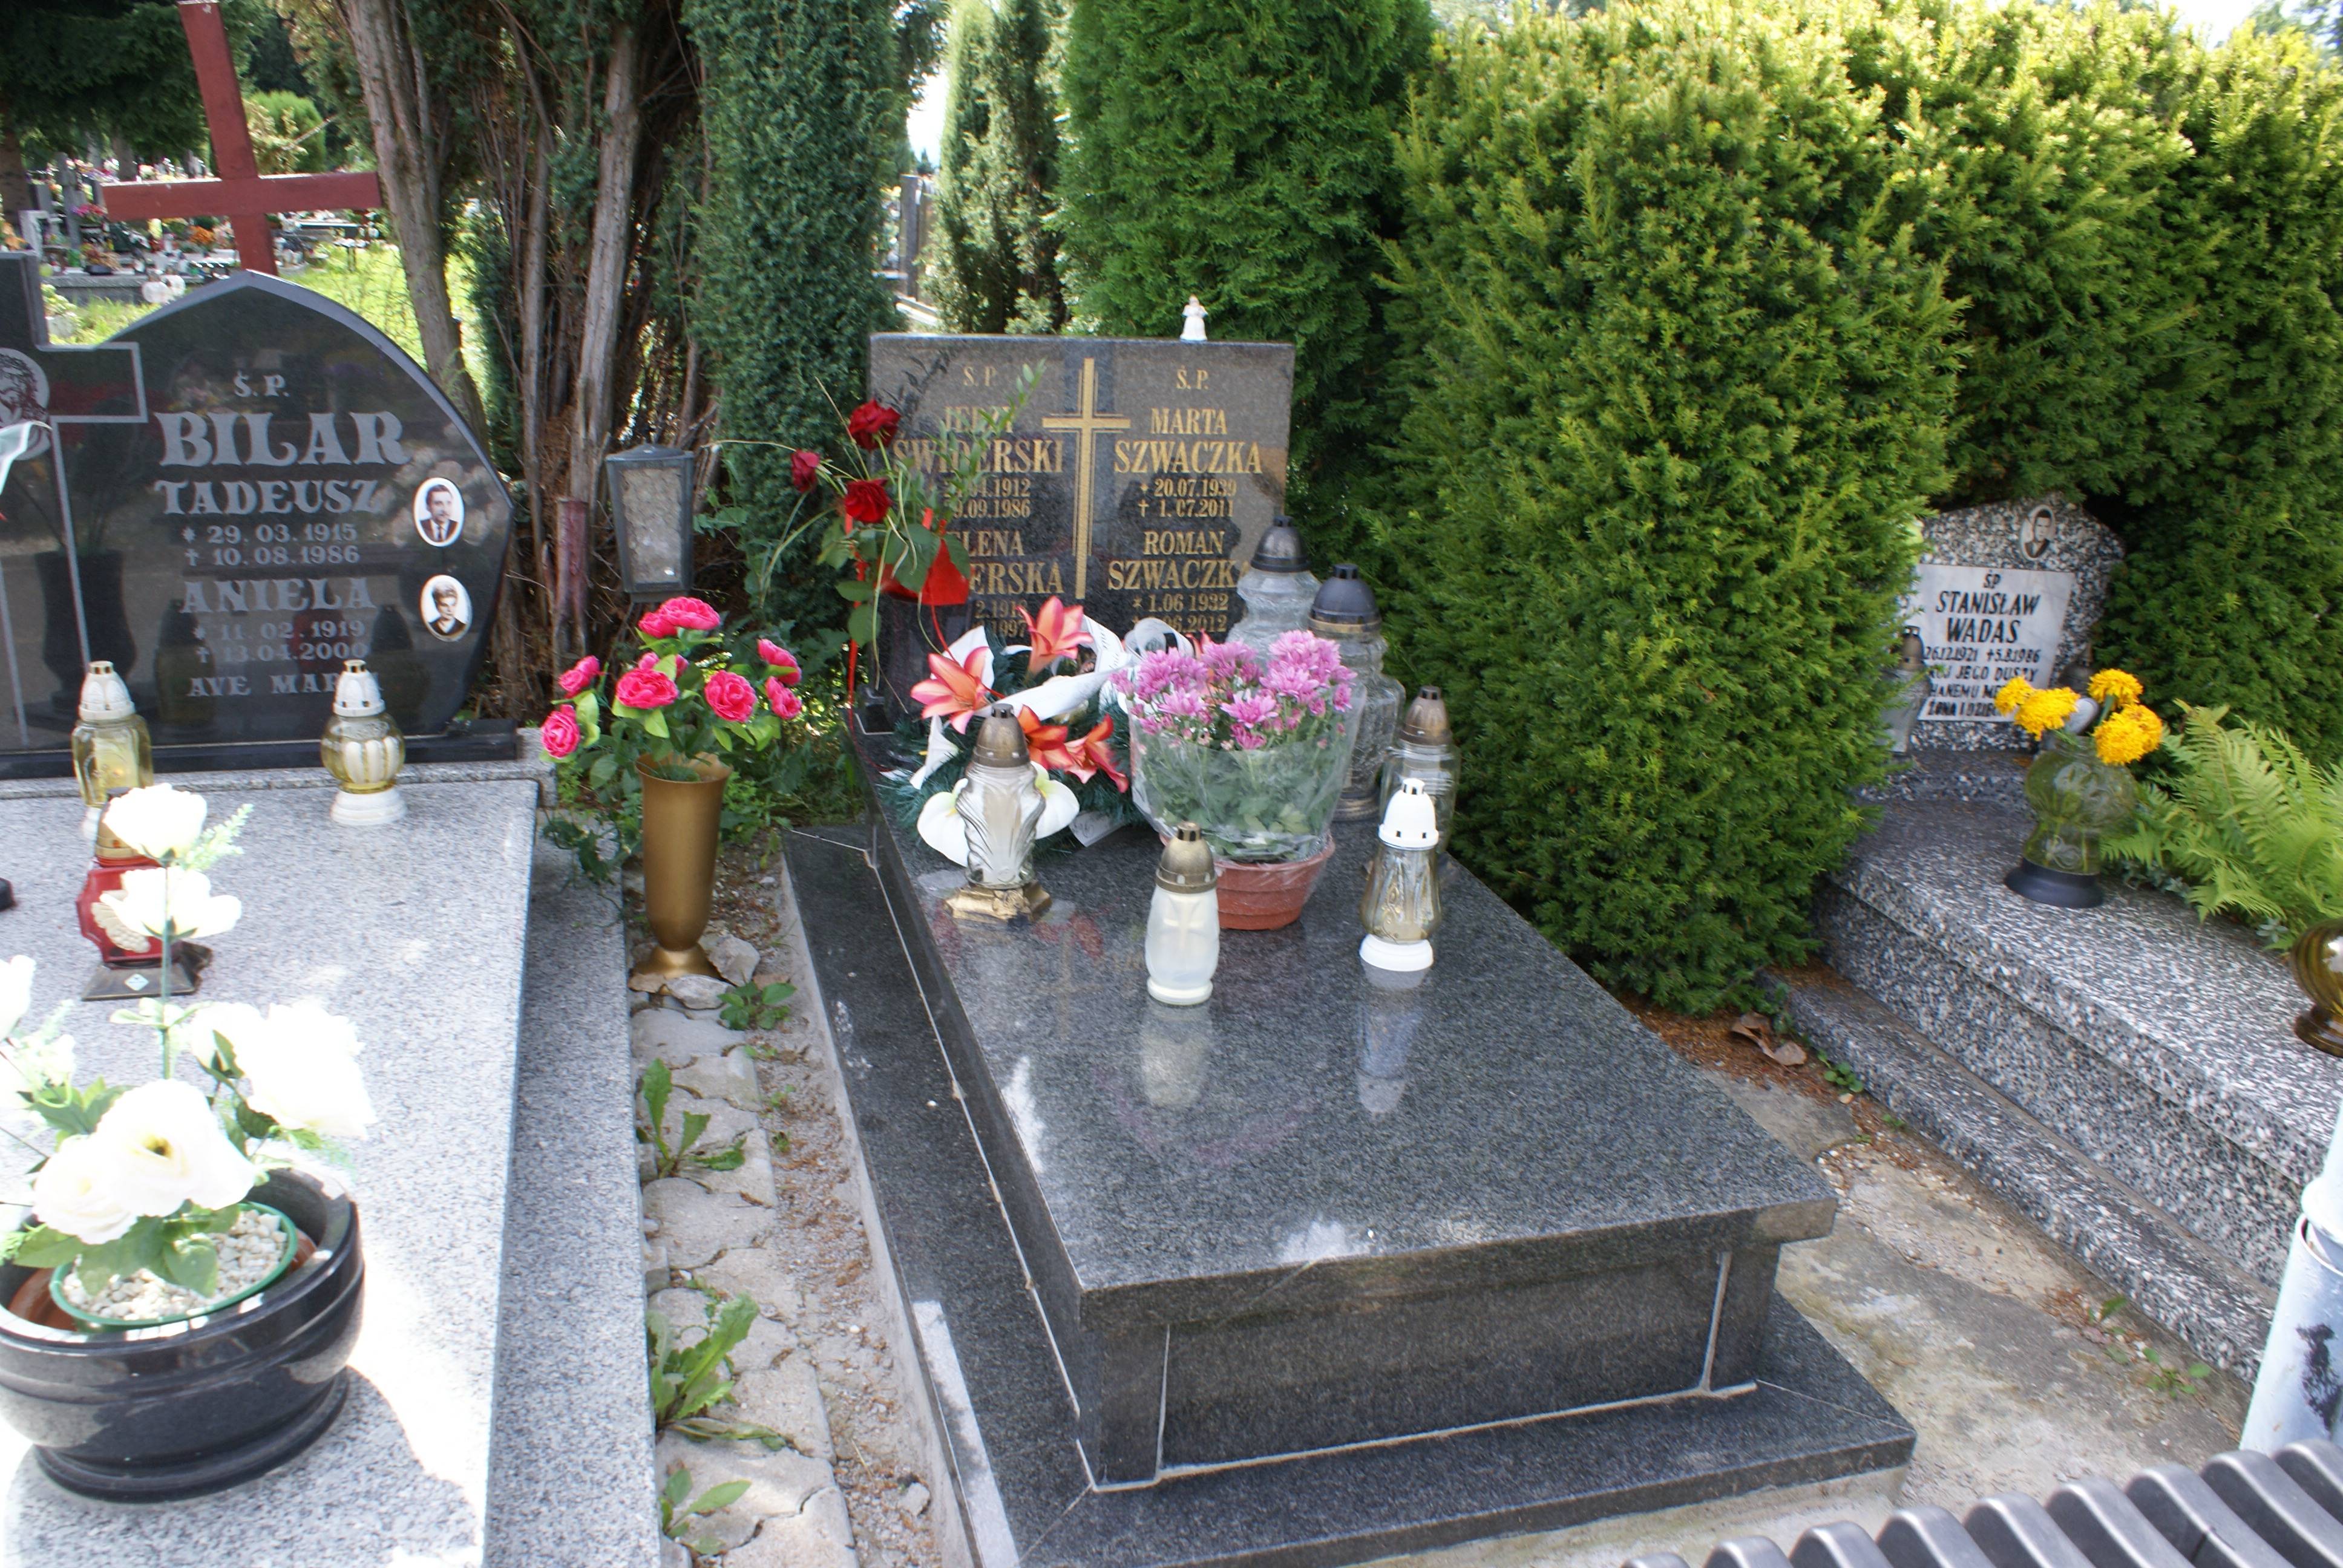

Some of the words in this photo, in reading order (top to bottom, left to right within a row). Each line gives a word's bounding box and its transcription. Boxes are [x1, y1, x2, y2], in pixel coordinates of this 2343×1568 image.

[1151, 407, 1228, 434] MARTA
[155, 411, 413, 466] BILAR
[1114, 440, 1263, 474] SZWACZKA
[155, 480, 384, 515] TADEUSZ
[1143, 530, 1225, 555] ROMAN
[181, 577, 377, 613] ANIELA
[969, 561, 1064, 595] ERSKA
[1945, 616, 2021, 644] WADAS
[188, 676, 251, 696] AVE
[269, 673, 383, 694] MAR
